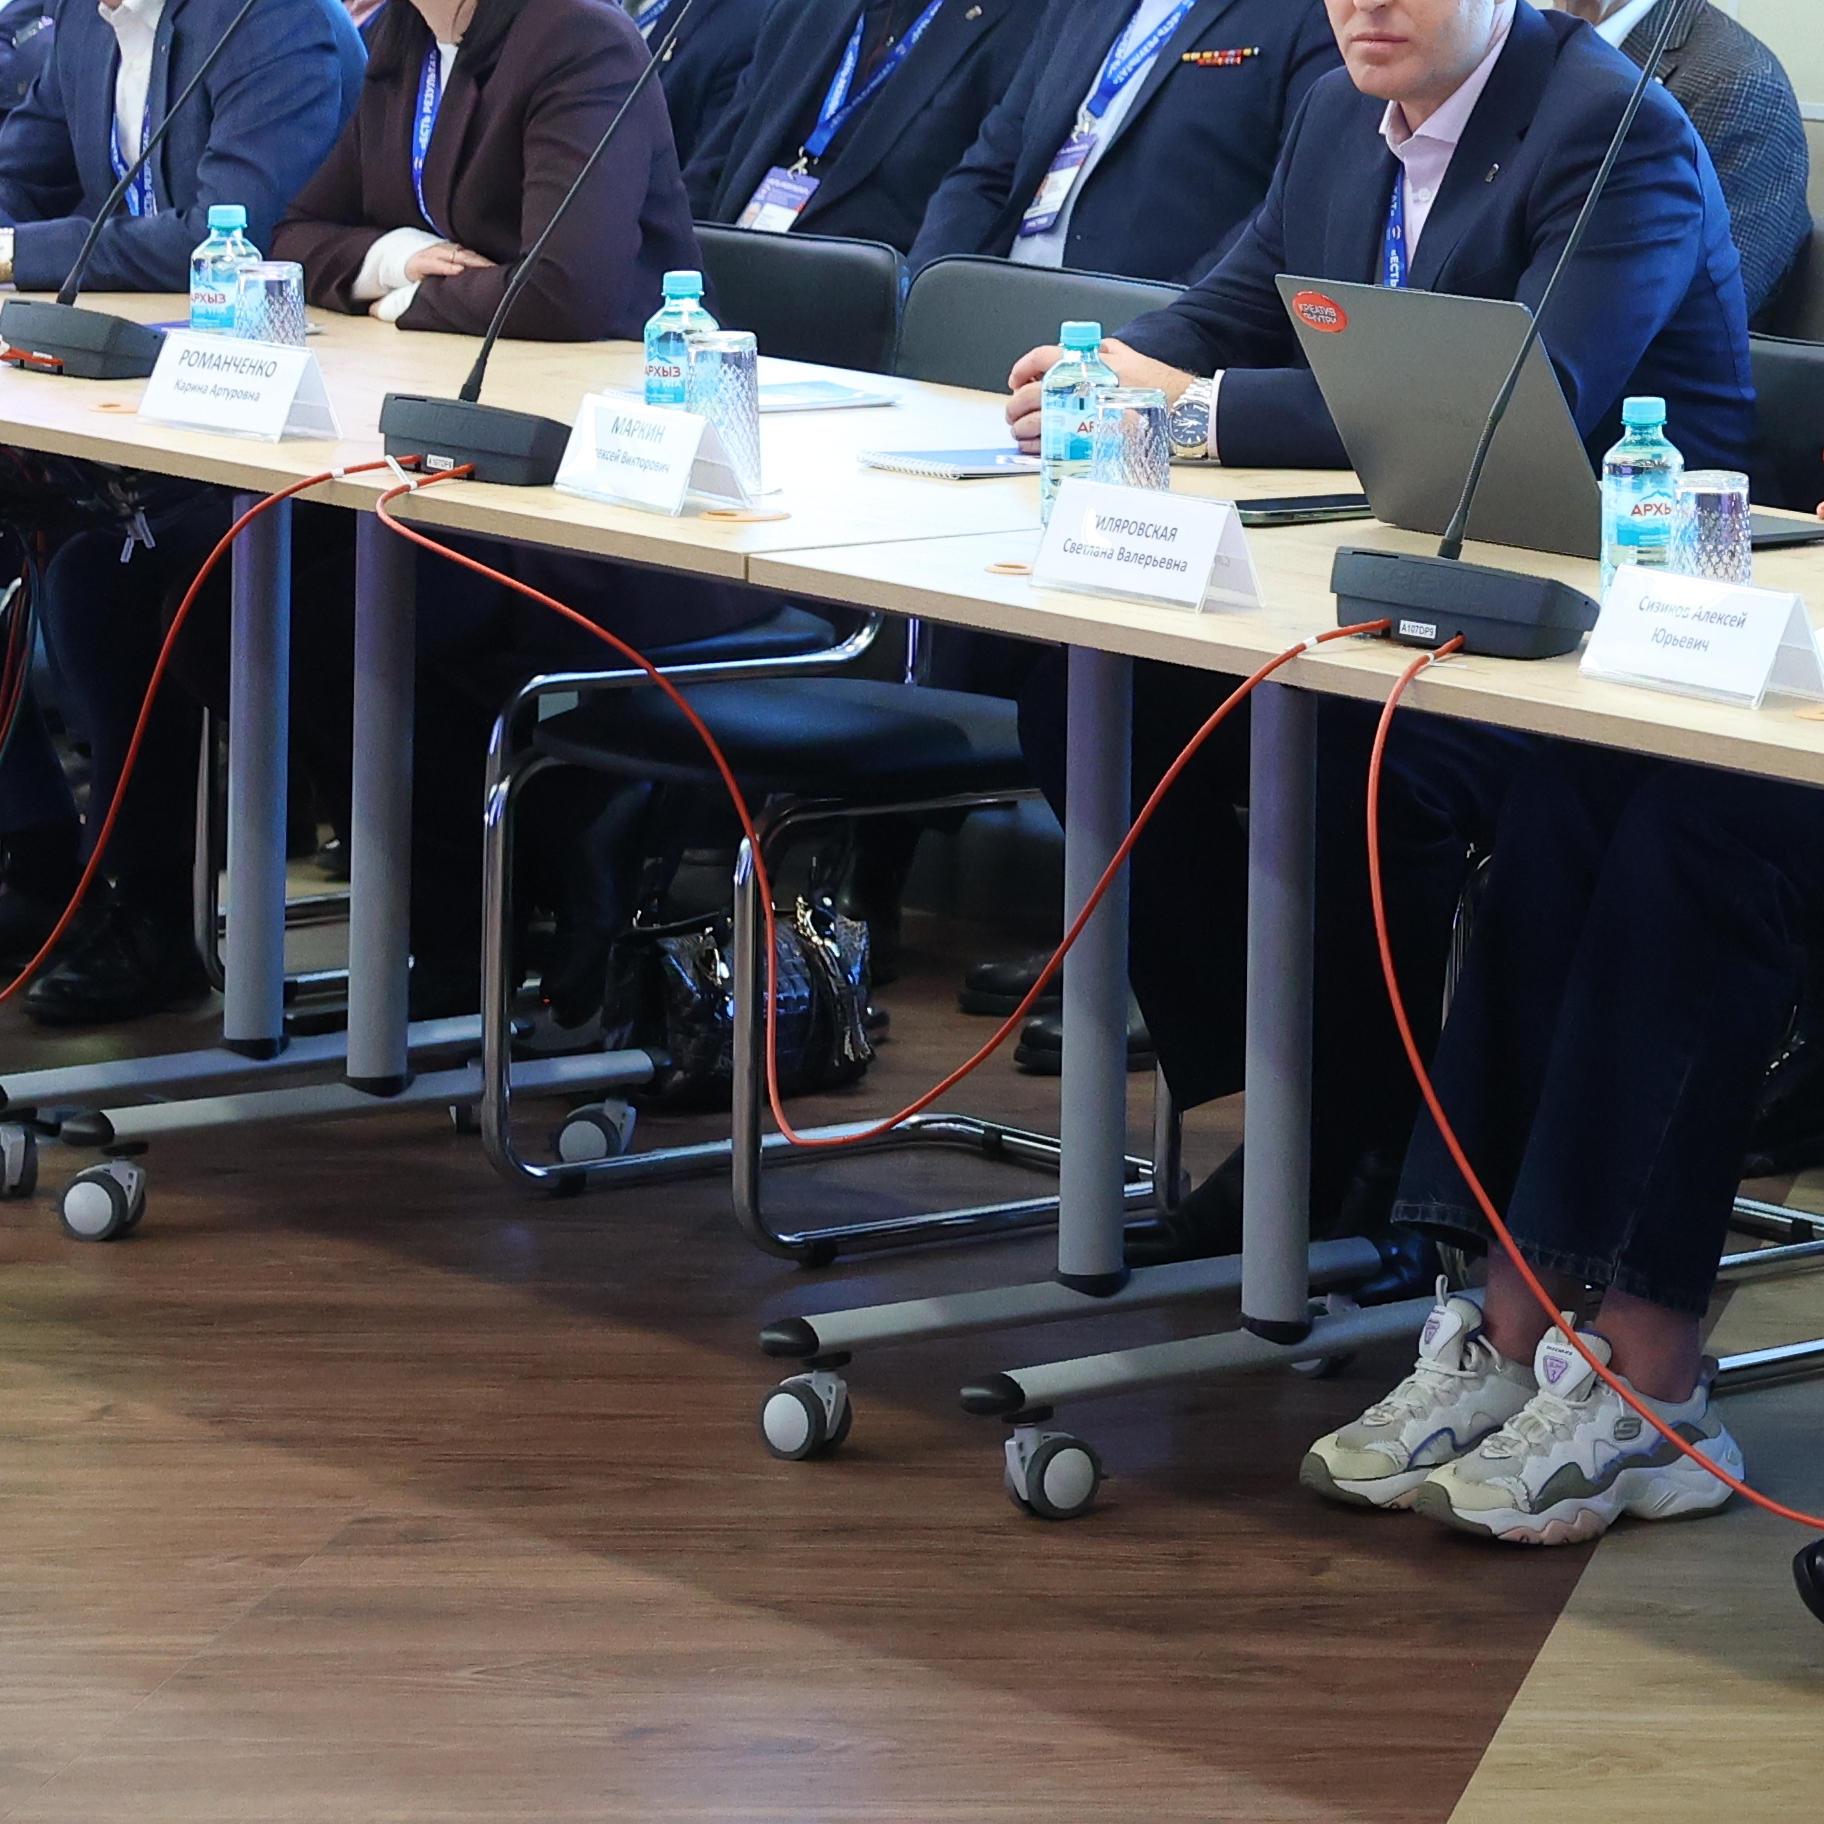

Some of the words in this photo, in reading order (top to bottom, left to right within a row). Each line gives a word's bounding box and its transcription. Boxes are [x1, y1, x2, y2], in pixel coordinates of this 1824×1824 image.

[178, 349, 278, 378] РОМАНЧЕНКО
[173, 378, 209, 395] Карина
[209, 383, 261, 402] Артуровна
[611, 416, 667, 444] МАРКИН
[594, 447, 621, 463] ексей
[621, 451, 671, 474] Викторович
[1063, 538, 1115, 560] Светлана
[1116, 546, 1188, 573] Валерьевна
[1638, 595, 1691, 619] Сизиков
[1691, 606, 1749, 629] Алексей
[1651, 627, 1710, 652] Юрьевич
